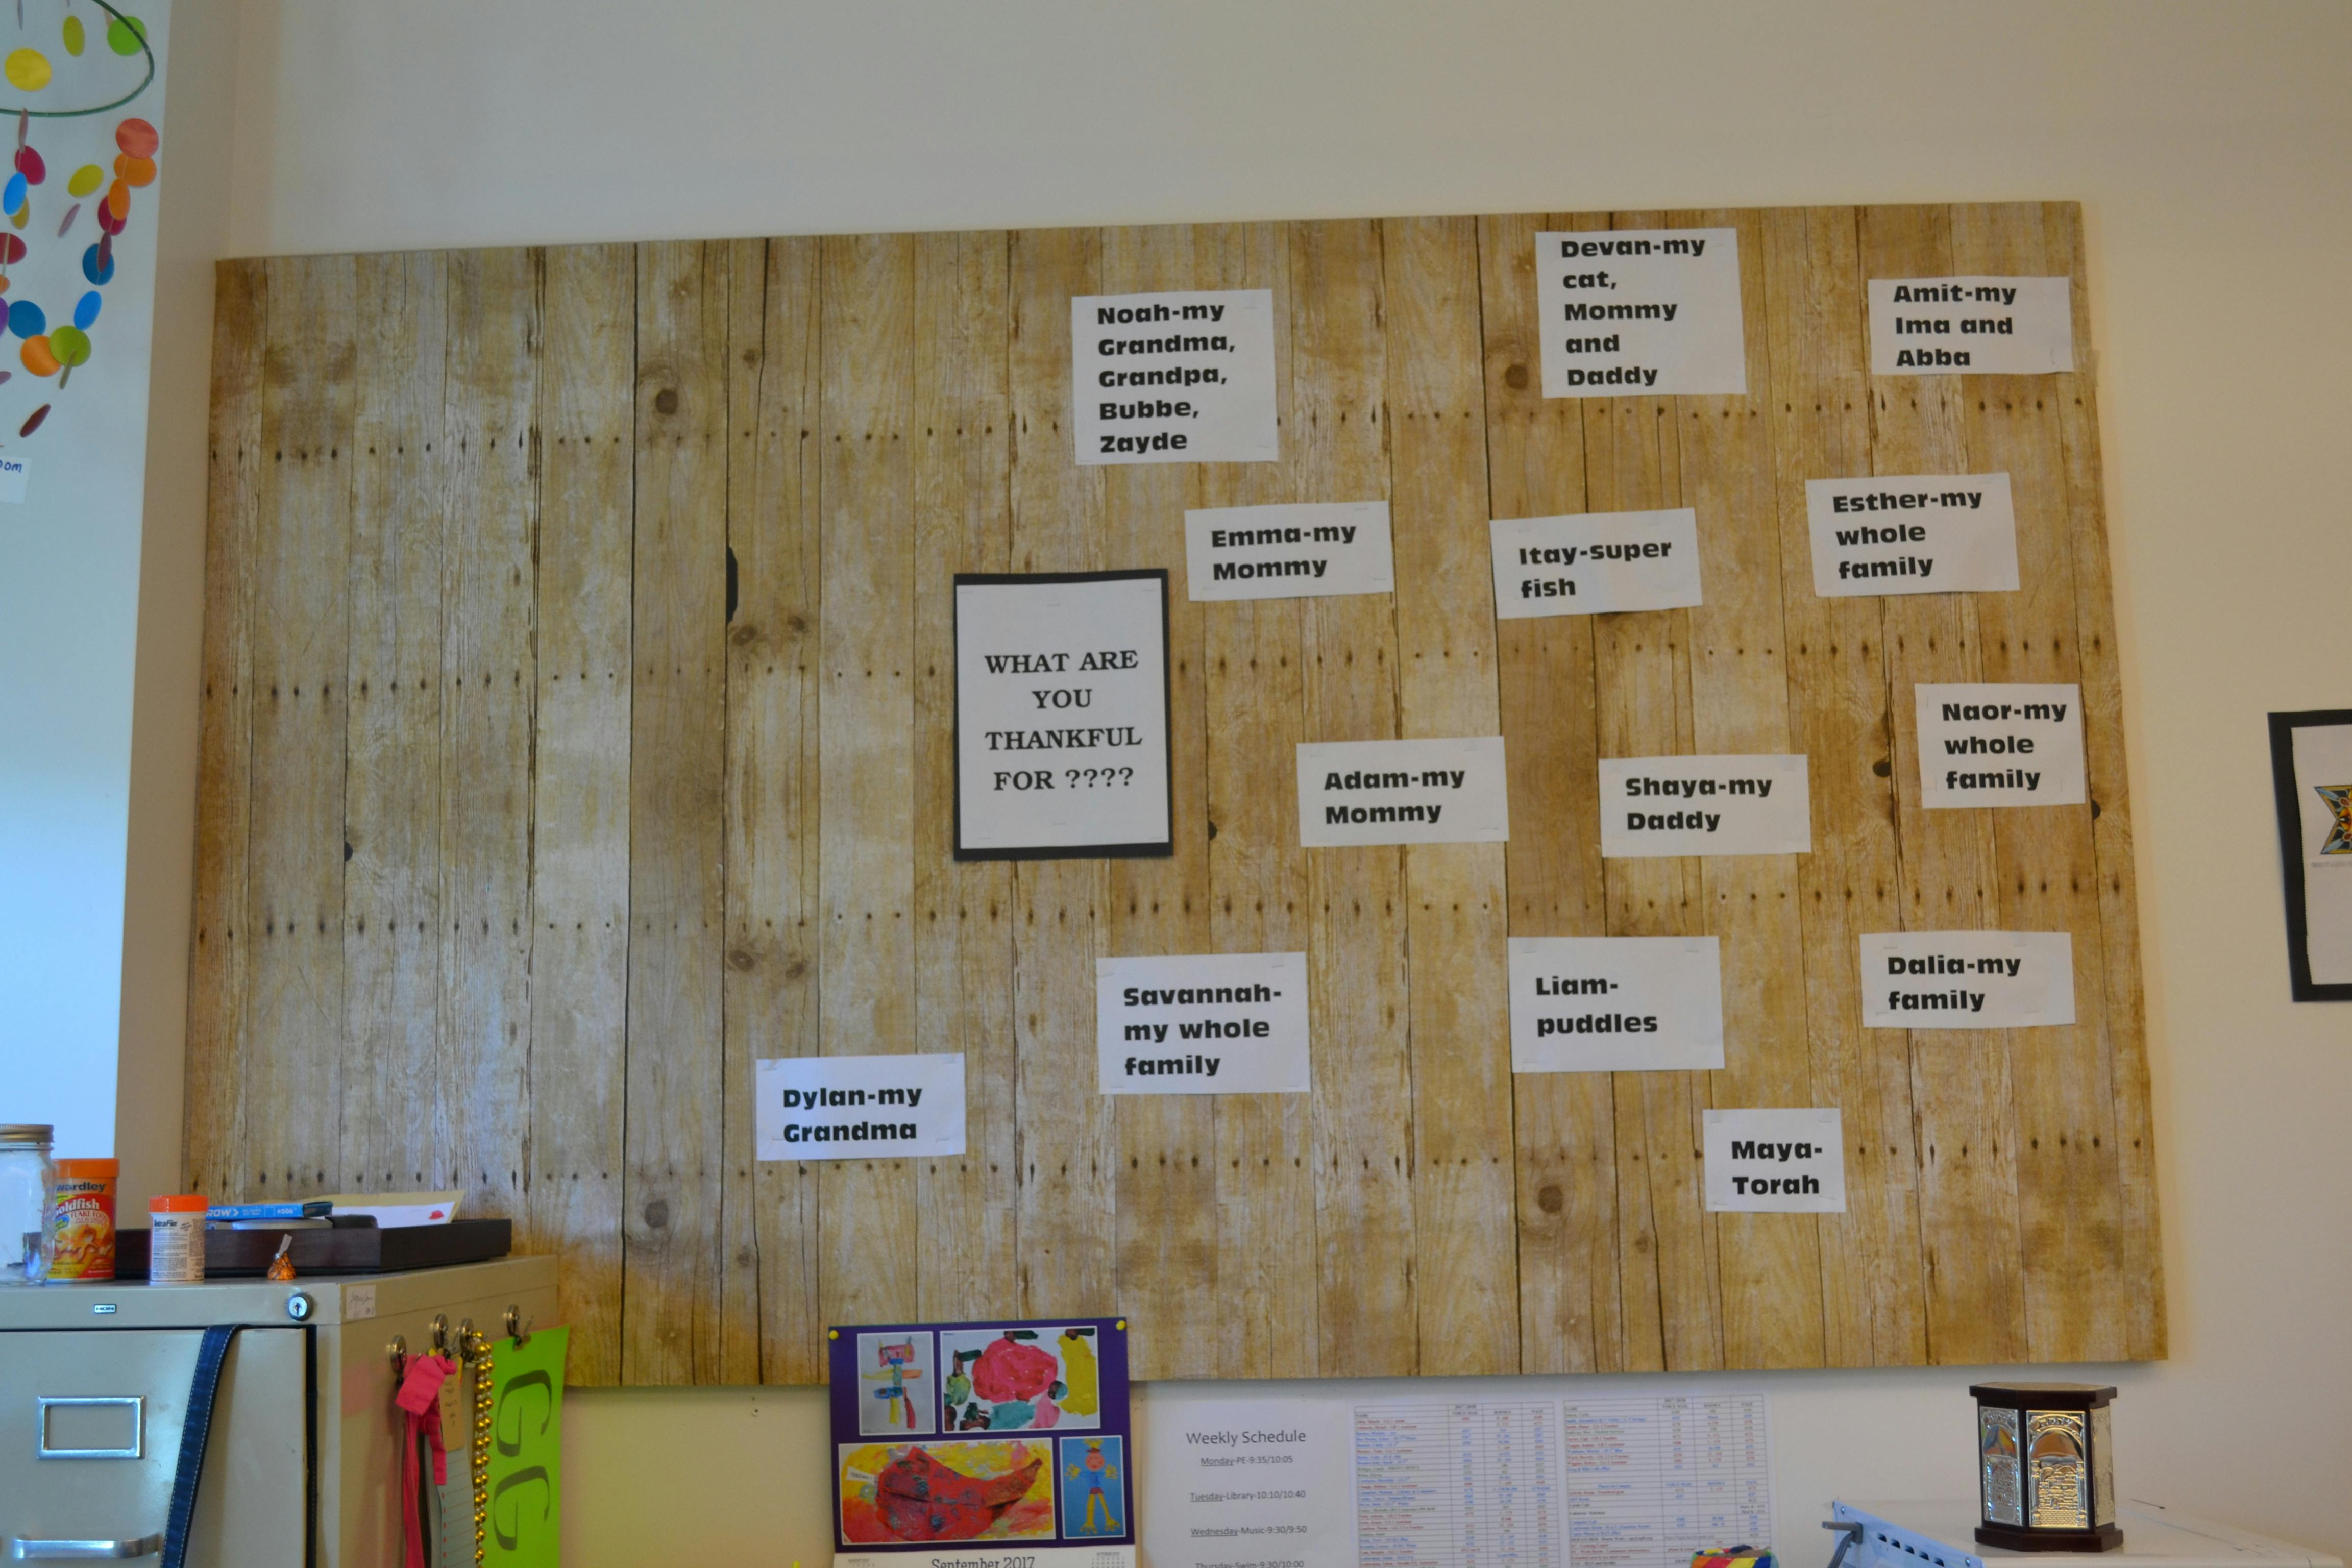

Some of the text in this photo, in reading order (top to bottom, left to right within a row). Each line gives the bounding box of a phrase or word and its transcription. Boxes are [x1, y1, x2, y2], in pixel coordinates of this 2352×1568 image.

[1561, 239, 1705, 258] Devan-my
[1563, 271, 1616, 290] cat,
[1894, 284, 2017, 305] Amit-my
[1098, 304, 1224, 325] Noah-my
[1564, 303, 1677, 321] Mommy
[1896, 317, 2013, 334] Ima and
[1098, 335, 1235, 356] Grandma,
[1566, 334, 1620, 354] and
[1896, 348, 1970, 366] Abba
[1099, 366, 1227, 387] Grandpa,
[1567, 366, 1658, 386] Daddy
[1100, 400, 1198, 420] Bubbe,
[1100, 432, 1187, 454] Zayde
[1833, 492, 1982, 513] Esther-my
[1212, 526, 1356, 548] Emma-my
[1835, 524, 1926, 546] whole
[1520, 542, 1672, 566] Itay-super
[1213, 560, 1327, 580] Mommy
[1839, 556, 1933, 579] family
[1521, 578, 1576, 598] fish
[984, 650, 1138, 674] WHAT ARE
[1032, 689, 1092, 709] YOU
[1942, 703, 2067, 722] Naor-my
[985, 727, 1142, 750] THANKFUL
[1944, 736, 2034, 755] whole
[994, 767, 1133, 791] FOR ????
[1324, 771, 1465, 790] Adam-my
[1626, 777, 1772, 798] Shaya-my
[1946, 769, 2041, 791] family
[1326, 805, 1442, 824] Mommy
[1627, 811, 1721, 832] Daddy
[1888, 955, 2021, 977] Dalia-my
[1123, 984, 1281, 1006] Savannah-
[1536, 976, 1618, 995] Liam-
[1888, 990, 1985, 1012] family
[1124, 1019, 1269, 1043] my whole
[1537, 1014, 1658, 1037] puddles
[1125, 1055, 1220, 1077] family
[783, 1088, 922, 1110] Dylan-my
[783, 1121, 917, 1143] Grandma
[1732, 1141, 1822, 1162] Maya-
[1732, 1175, 1819, 1195] Torah
[1186, 1430, 1307, 1447] Weekly Schedule
[932, 1557, 1035, 1568] September 2017
